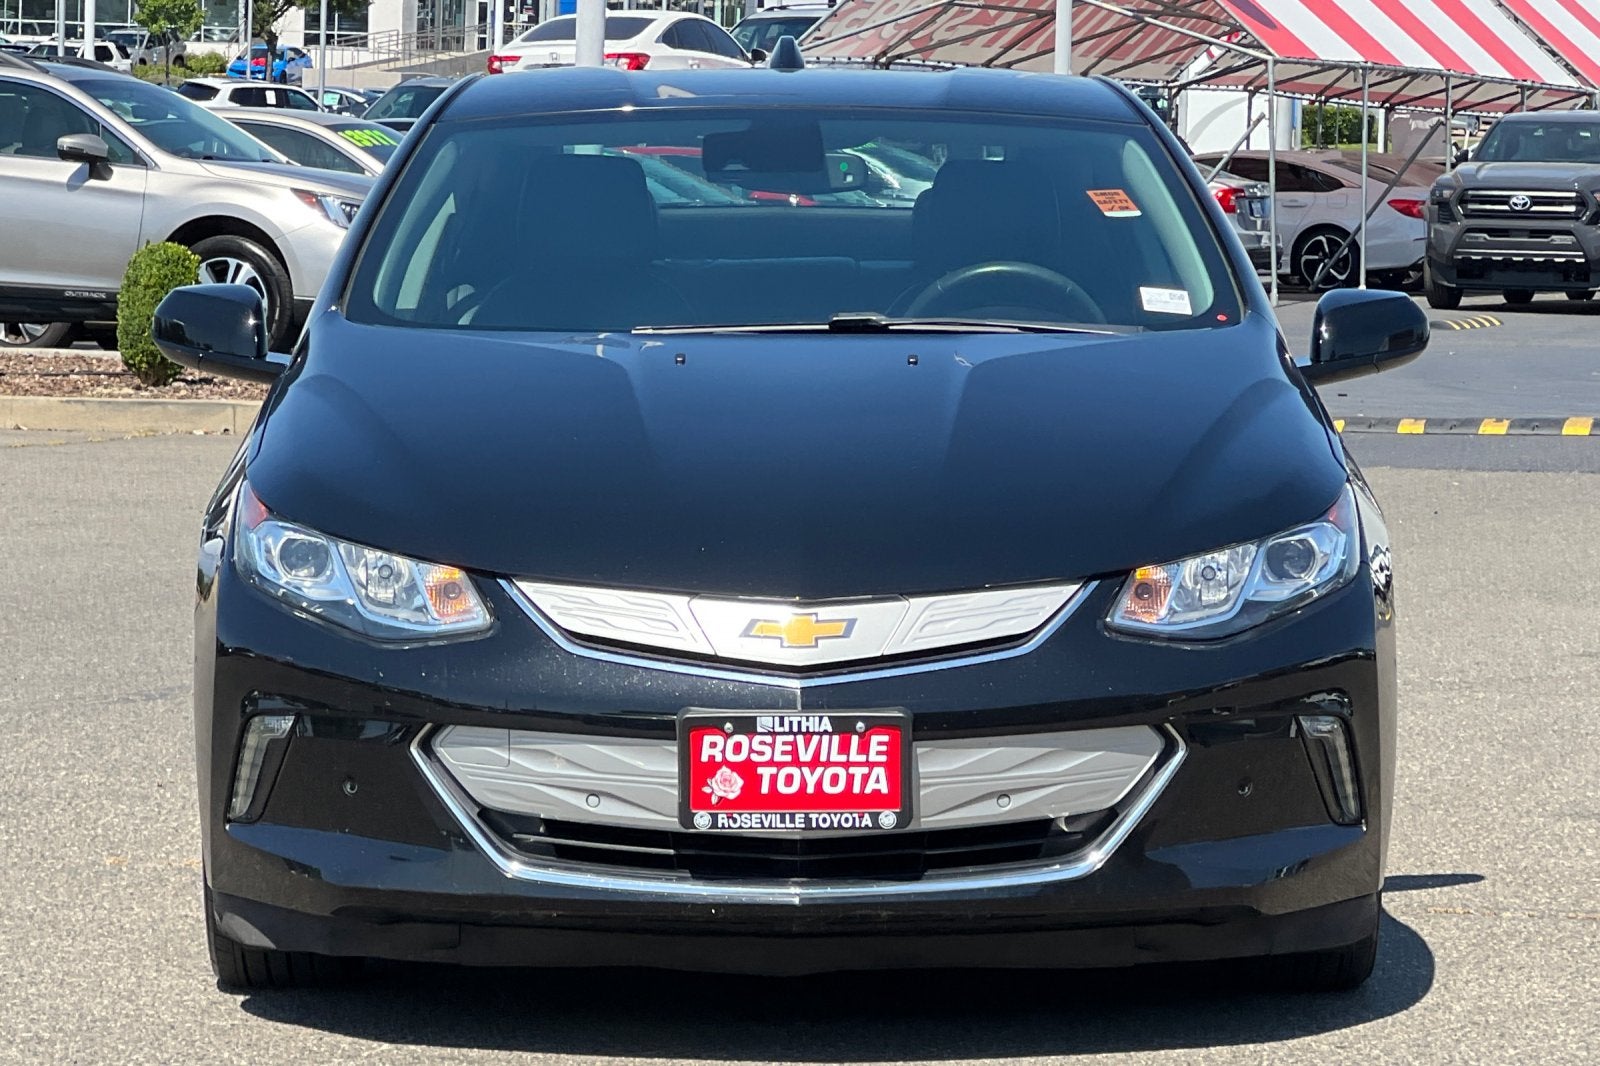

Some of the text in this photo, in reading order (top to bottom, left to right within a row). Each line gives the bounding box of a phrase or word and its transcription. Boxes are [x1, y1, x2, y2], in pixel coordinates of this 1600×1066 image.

[64, 290, 107, 299] OUTBACK
[772, 716, 833, 733] LITHIA
[700, 734, 890, 763] ROSEVILLE
[756, 765, 889, 795] TOYOTA
[717, 813, 873, 829] ROSEVILLE TOYOTA
